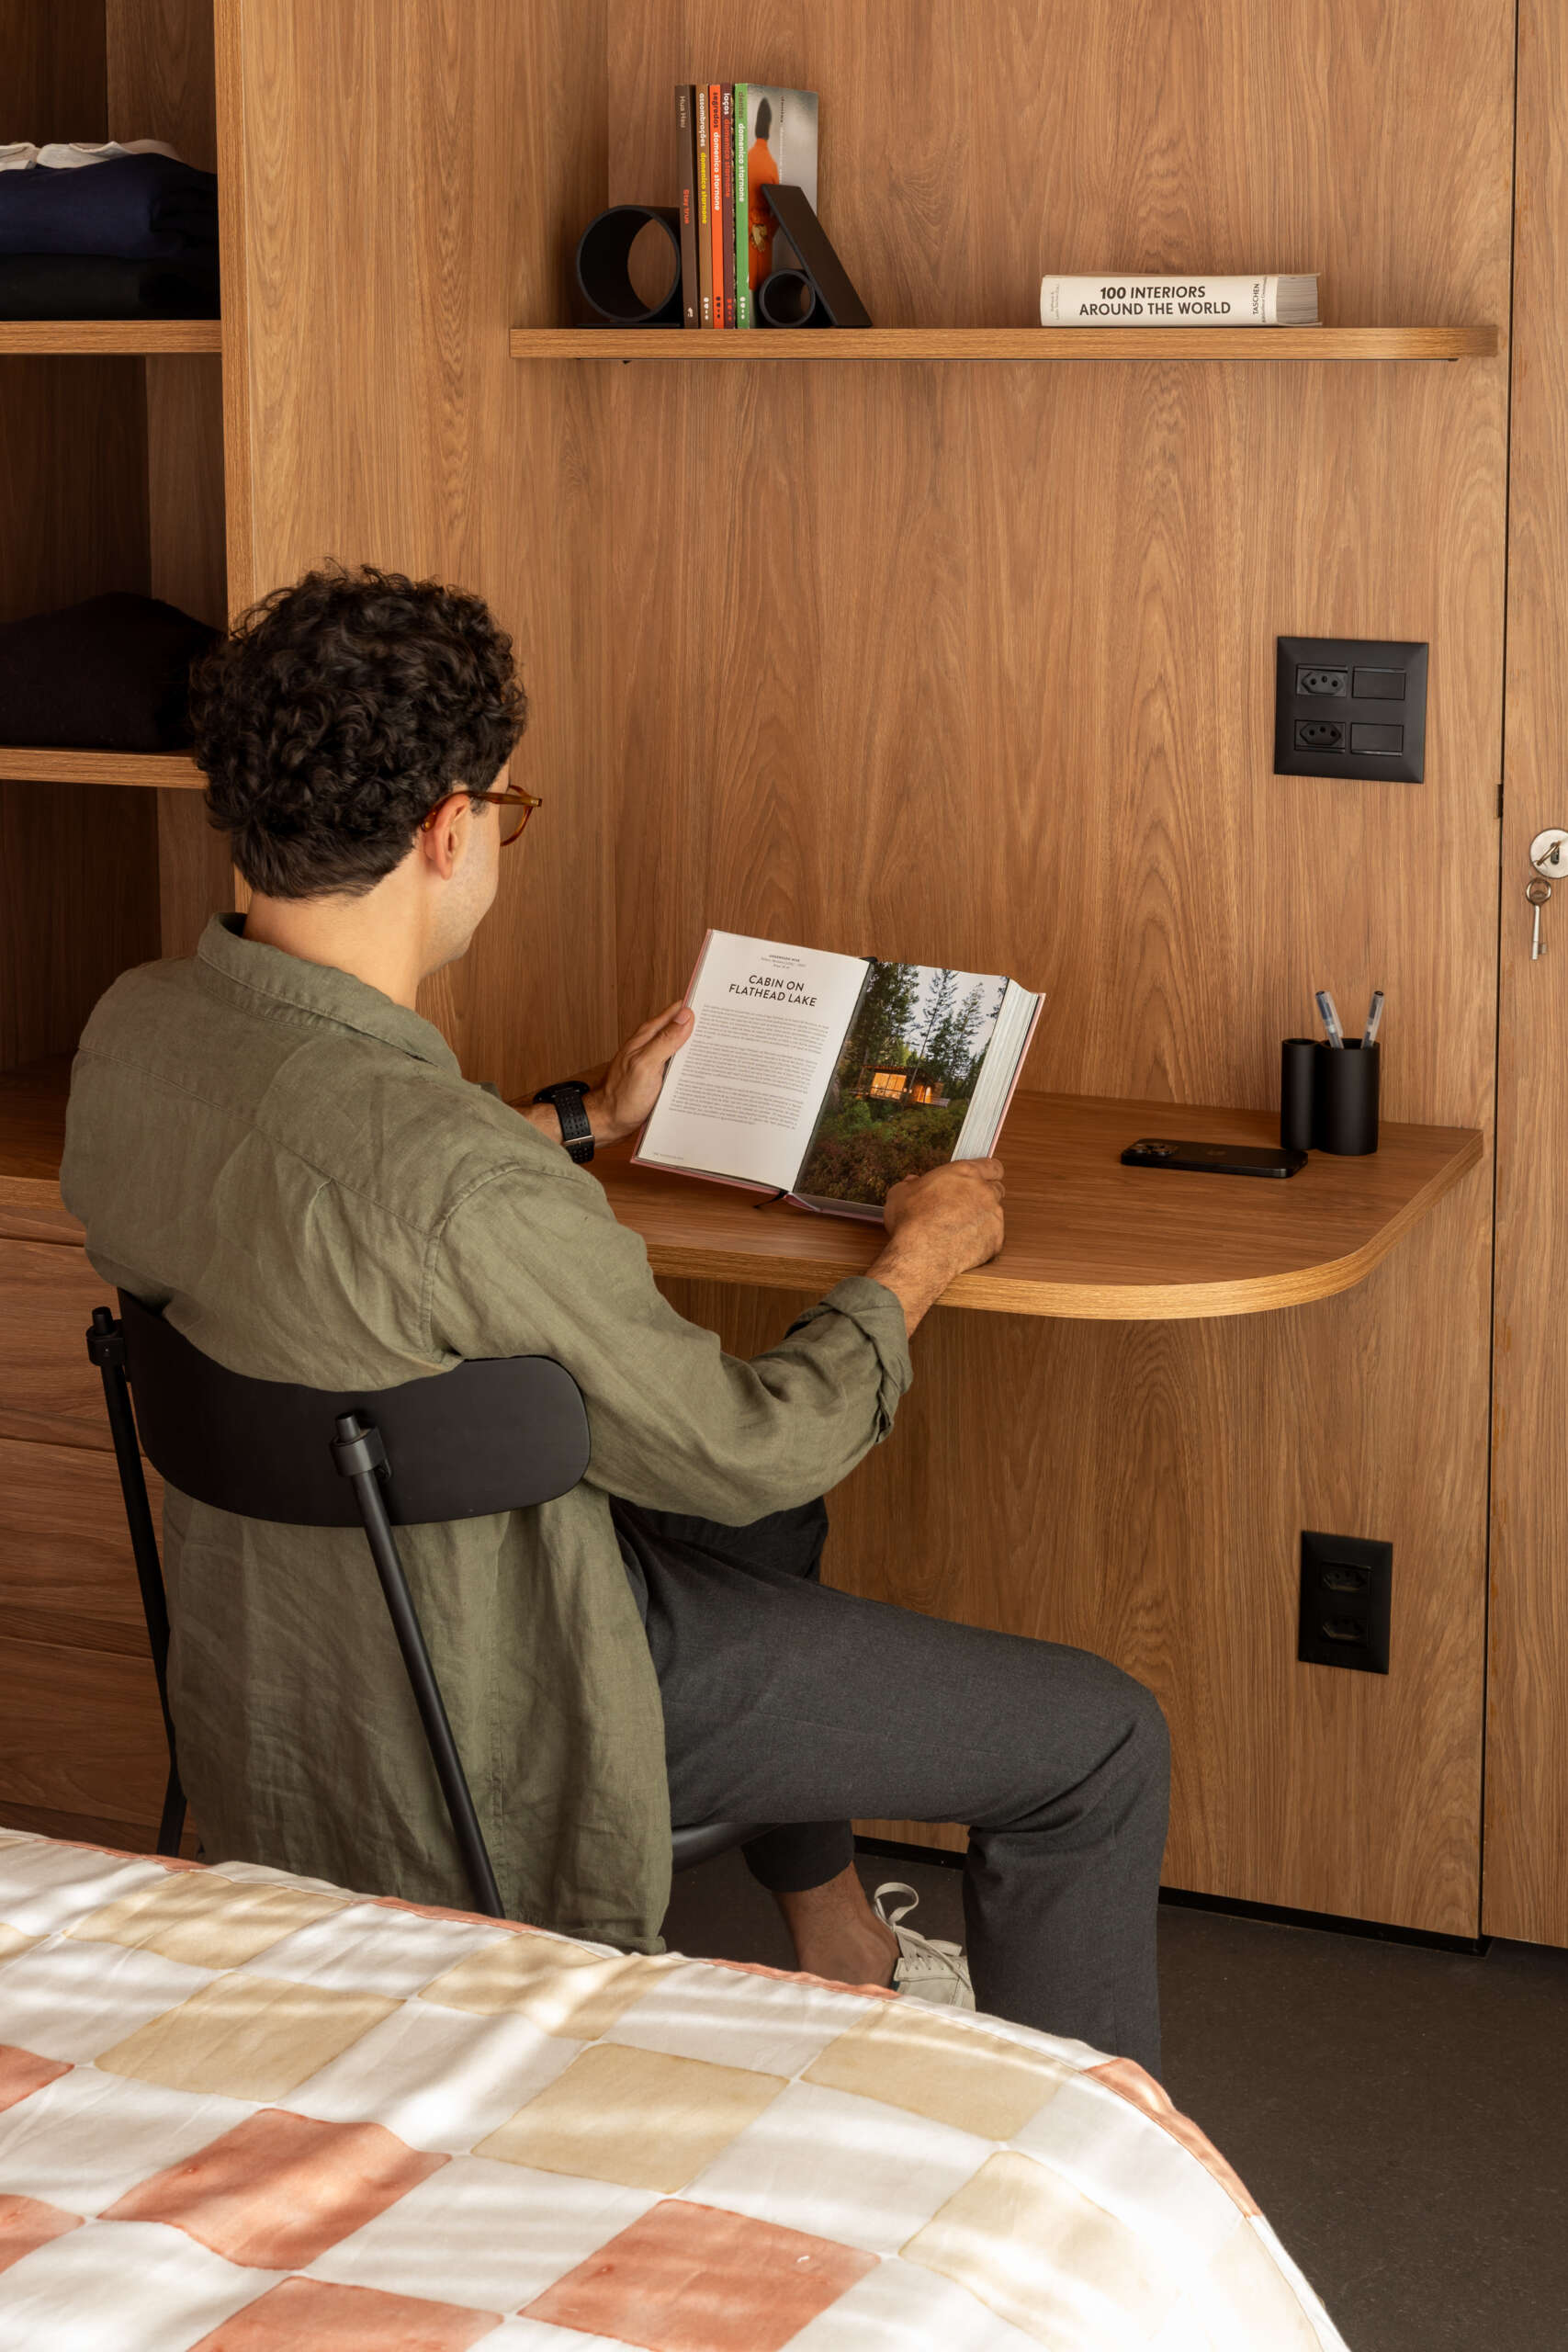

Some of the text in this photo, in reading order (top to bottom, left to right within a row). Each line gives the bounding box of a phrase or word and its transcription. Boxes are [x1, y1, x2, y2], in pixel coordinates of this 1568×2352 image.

[722, 93, 730, 115] laços
[738, 123, 746, 164] domenico
[1100, 286, 1206, 300] 100 INTERIORS
[1079, 301, 1231, 315] AROUND THE WORLD
[749, 975, 805, 991] CABIN ON
[728, 983, 818, 1007] FLATHEAD LAKE
